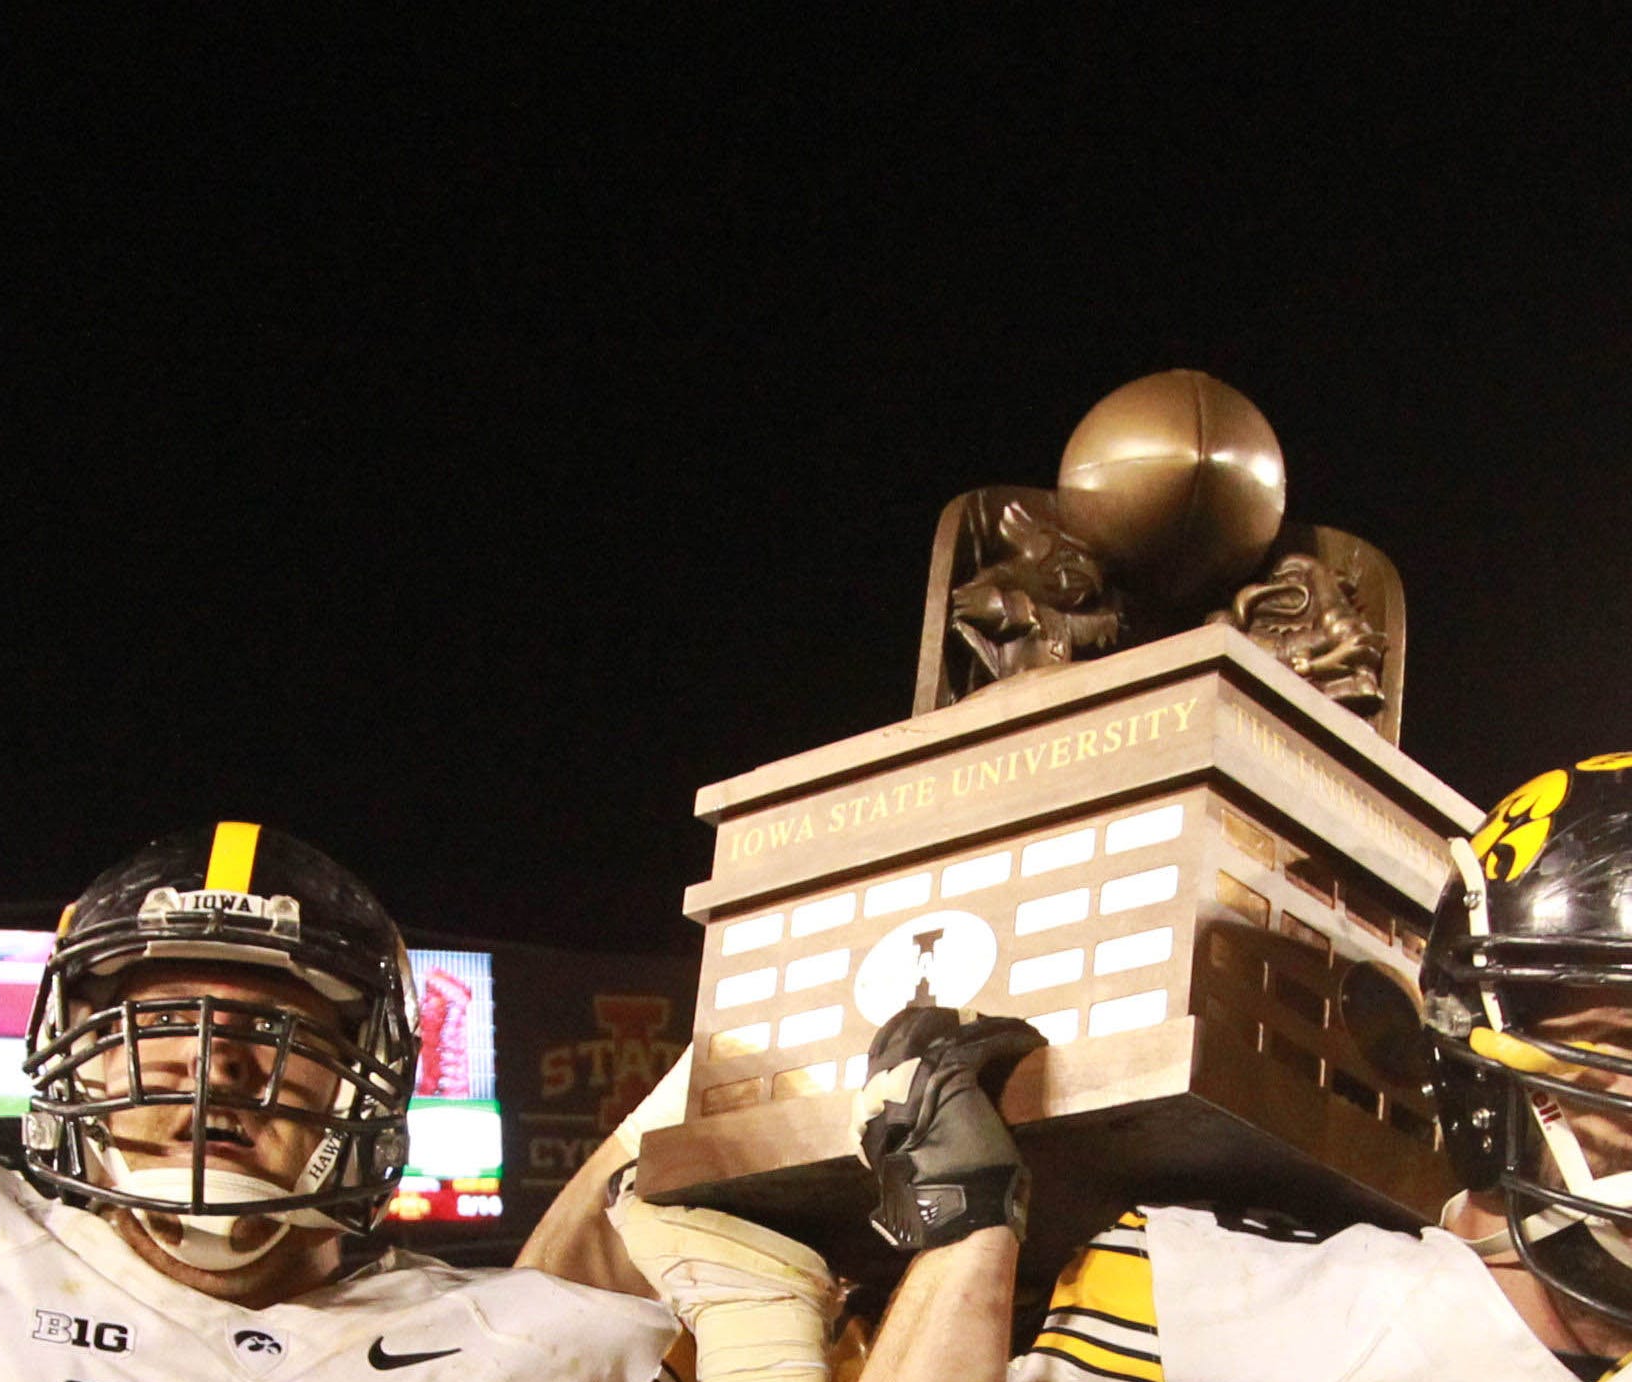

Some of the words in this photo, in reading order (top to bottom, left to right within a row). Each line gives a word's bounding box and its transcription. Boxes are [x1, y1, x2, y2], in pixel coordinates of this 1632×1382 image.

[729, 816, 815, 862] IOWA
[827, 775, 937, 834] STATE
[951, 696, 1199, 798] UNIVERSITY
[192, 894, 254, 913] IOWA
[540, 1038, 687, 1097] STA
[309, 1136, 342, 1180] HAW
